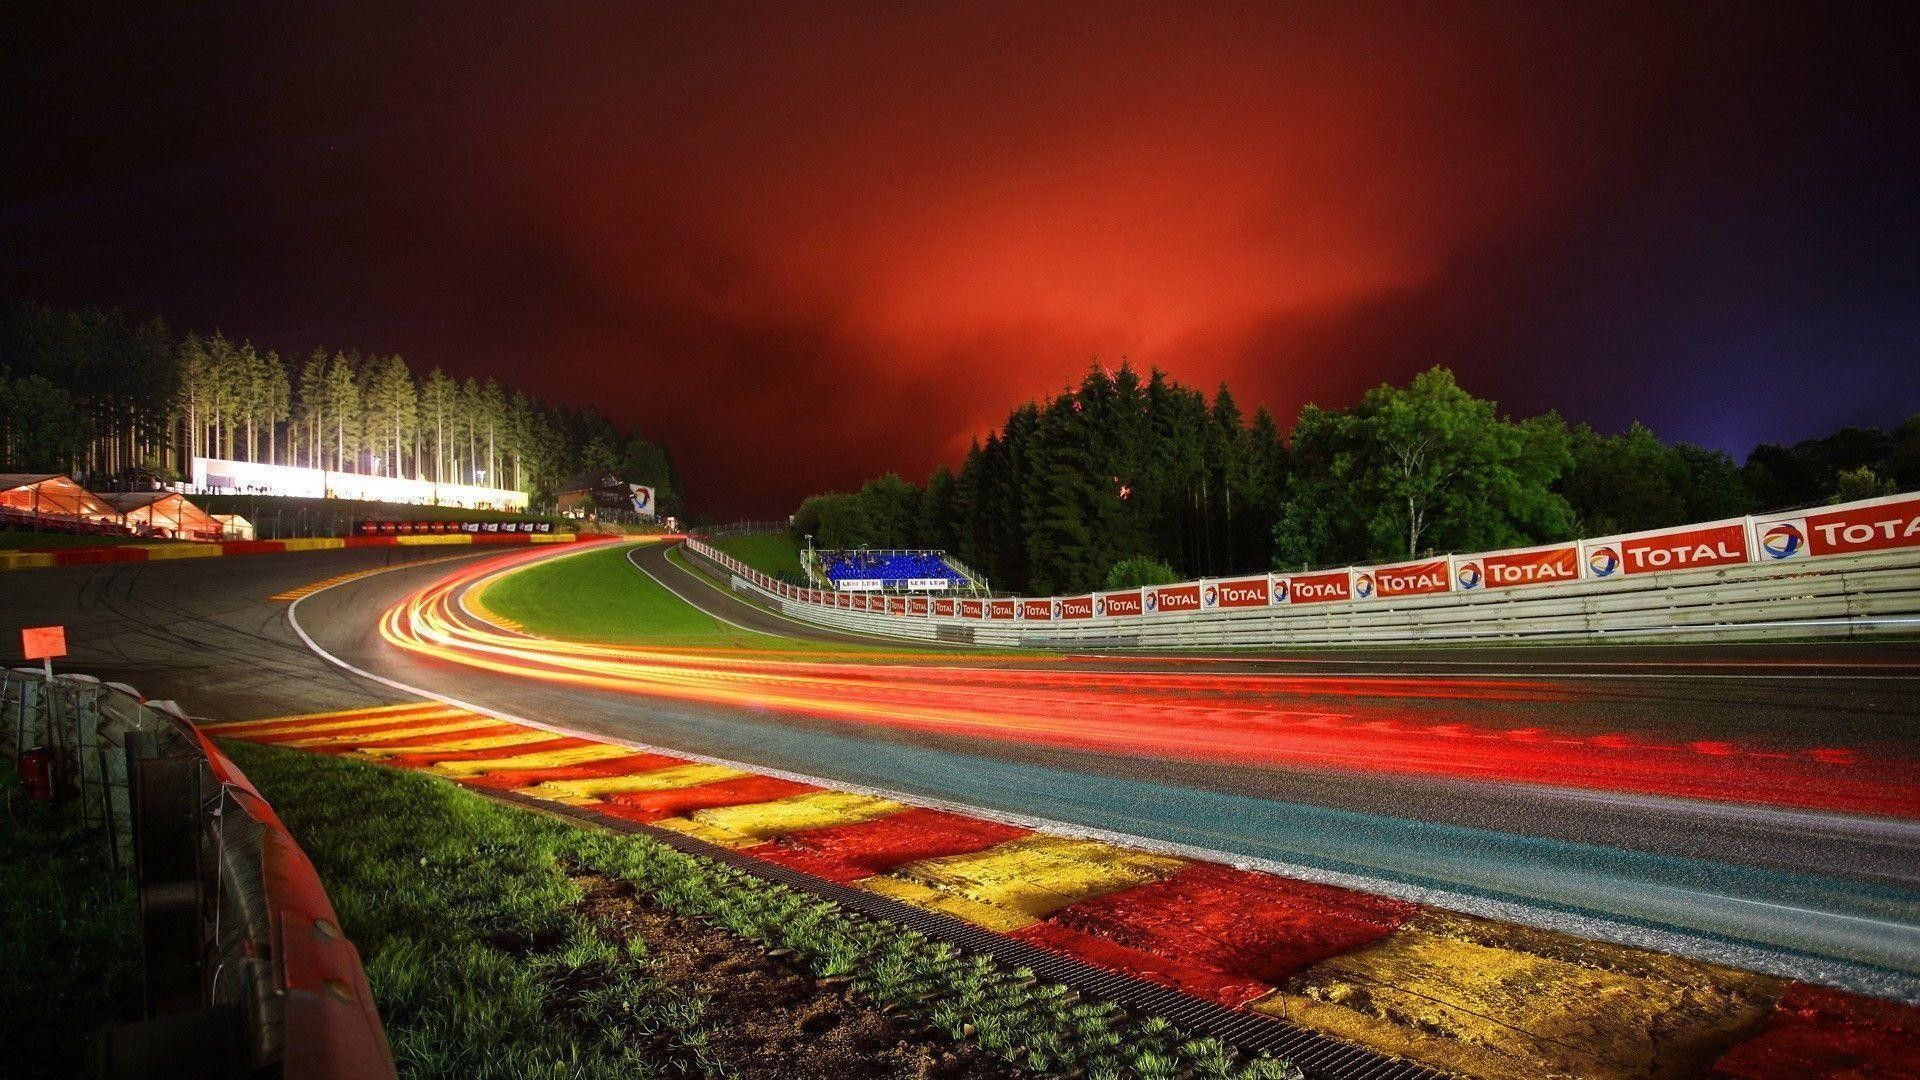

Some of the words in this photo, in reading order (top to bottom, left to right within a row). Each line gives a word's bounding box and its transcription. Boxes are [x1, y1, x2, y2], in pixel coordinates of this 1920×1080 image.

[1814, 516, 1920, 546] TOTA
[1627, 541, 1741, 567] TOTAL
[1487, 561, 1574, 582] TOTAL
[1378, 573, 1446, 591] TOTAL
[1221, 588, 1266, 602] TOTAL
[1292, 582, 1348, 597] TOTAL
[891, 601, 905, 610] TOTAL
[1107, 600, 1140, 611] TOTAL
[1159, 593, 1198, 606] TOTAL
[912, 601, 928, 611] TOTAL
[936, 603, 953, 613] TOTAL
[962, 604, 982, 615] TOTAL
[992, 605, 1013, 615] TOTAL
[1025, 605, 1050, 616] TOTAL
[1063, 603, 1091, 615] TOTAL
